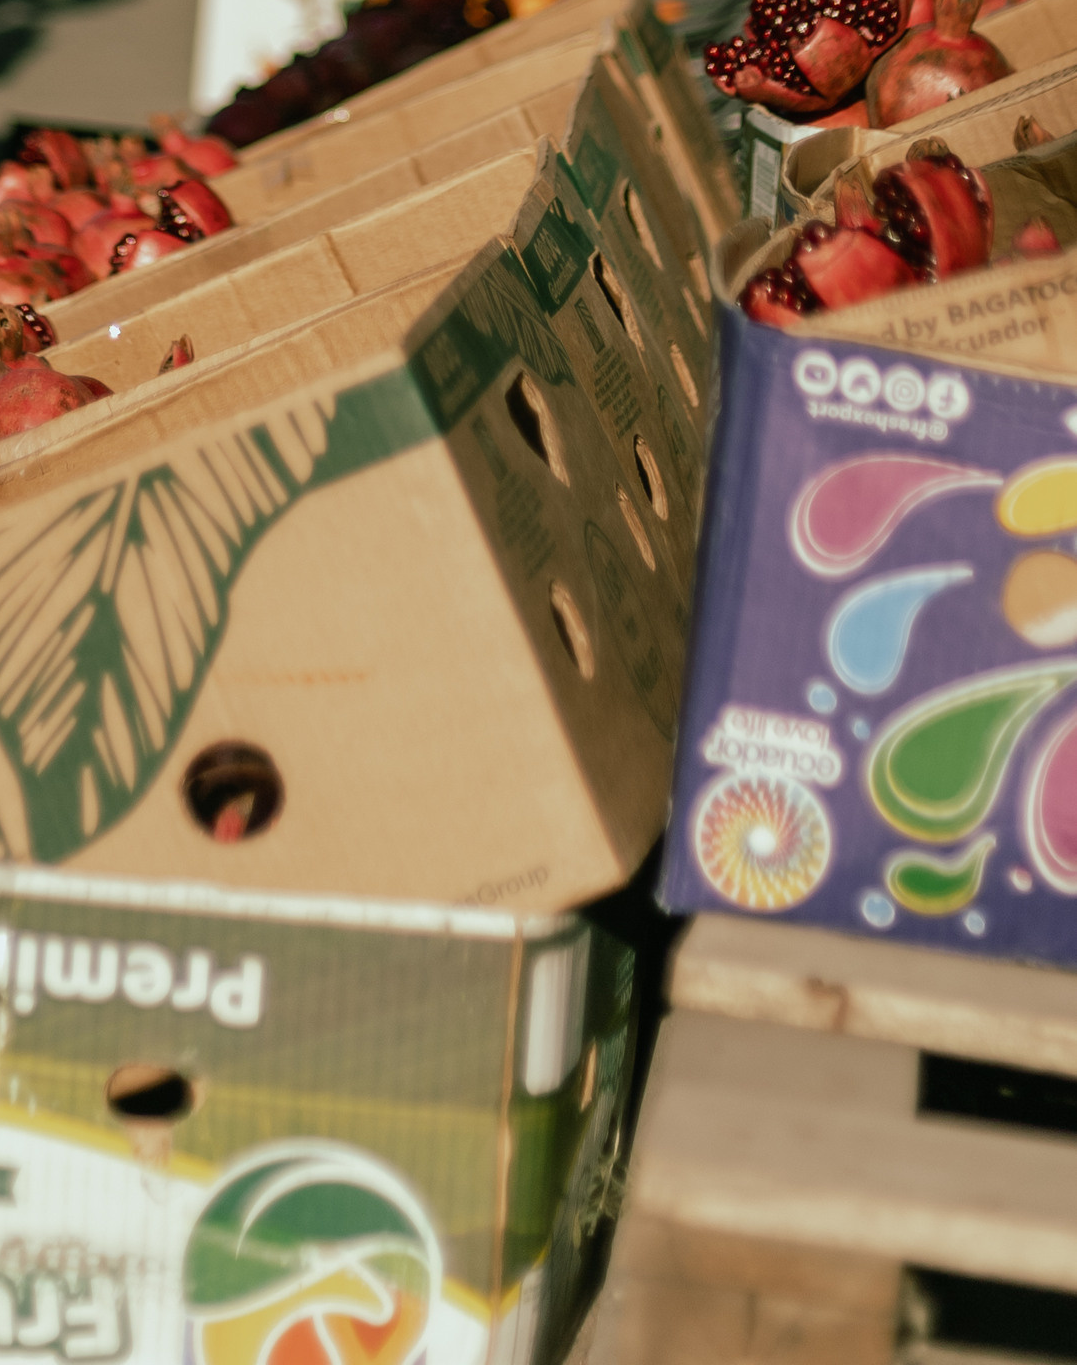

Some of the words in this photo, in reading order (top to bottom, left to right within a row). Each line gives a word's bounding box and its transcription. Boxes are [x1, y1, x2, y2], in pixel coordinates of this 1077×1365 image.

[902, 315, 938, 342] by
[807, 399, 949, 441] @freshexport
[712, 735, 837, 775] ecuador
